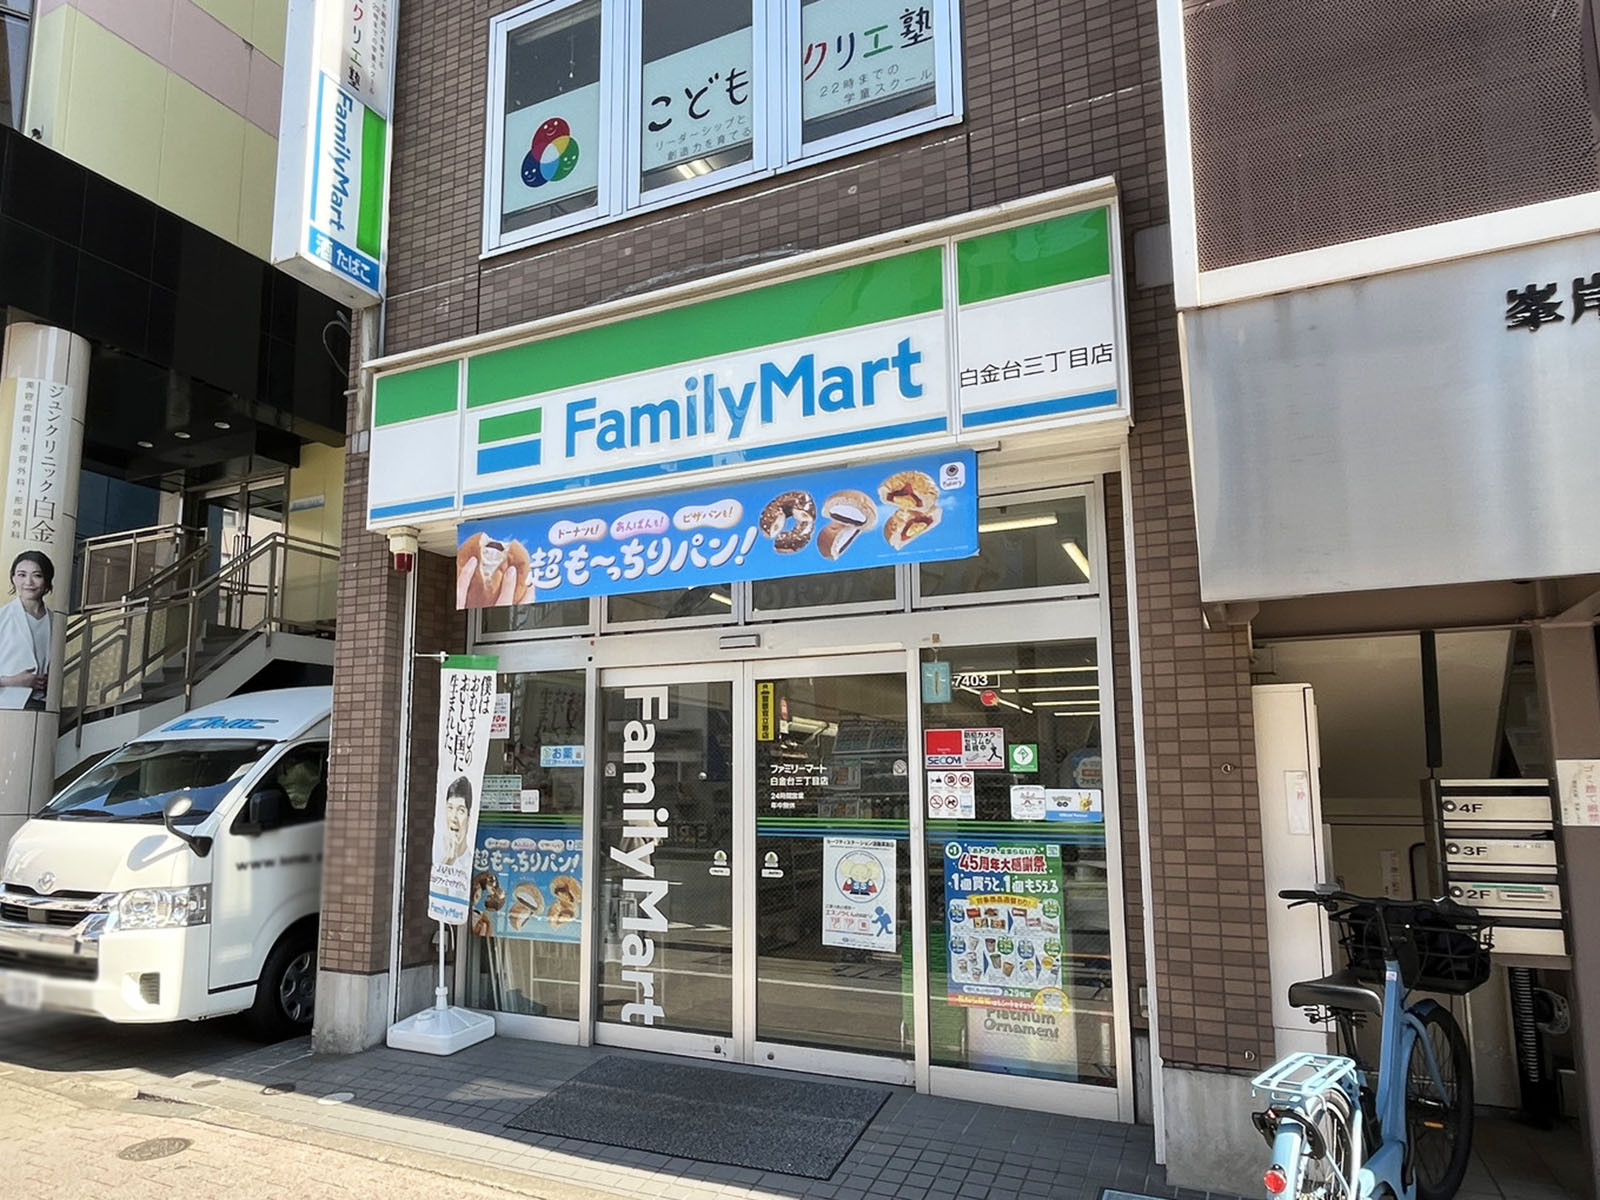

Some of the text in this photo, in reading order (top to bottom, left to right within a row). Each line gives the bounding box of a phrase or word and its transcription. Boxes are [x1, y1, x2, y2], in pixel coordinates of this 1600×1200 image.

[348, 0, 363, 91] クリエ塾
[648, 6, 933, 132] こども クリエ塾
[819, 63, 899, 98] 22時までの
[843, 69, 933, 105] 学童スクール
[655, 114, 748, 151] リーダーシップと
[667, 128, 751, 161] 創造力を育てる
[328, 88, 353, 232] FamilyMart
[336, 248, 371, 283] たばこ
[959, 342, 1114, 388] 白金台三丁目店
[565, 337, 924, 459] FamilyMart
[29, 384, 65, 545] ジュンクリニック白金
[479, 675, 492, 714] 僕は
[952, 675, 988, 687] 7403
[769, 763, 828, 774] ファミリーマート
[927, 756, 962, 765] SECOM
[769, 776, 829, 787] 白金台三丁目店
[1459, 803, 1483, 813] 4F
[610, 685, 669, 1026] FamilyMart
[960, 854, 1045, 873] 45周年大感謝祭
[1463, 846, 1488, 856] 3F
[1467, 889, 1491, 900] 2F
[984, 1018, 1060, 1039] Ornament
